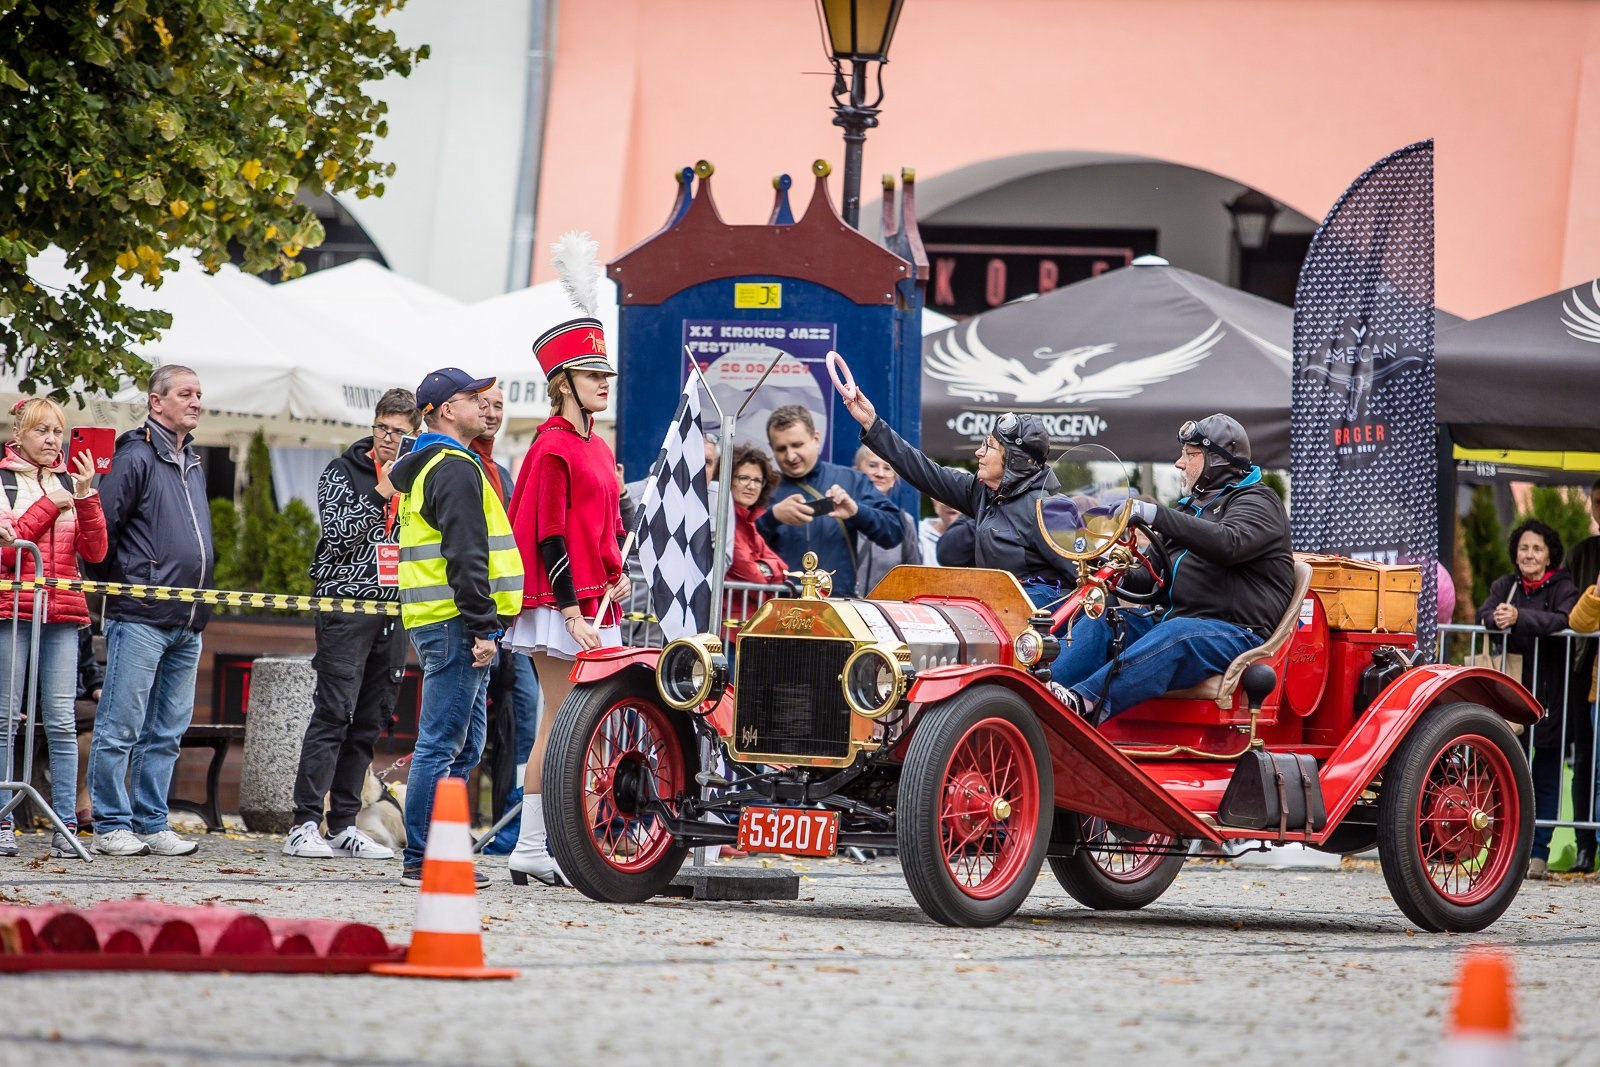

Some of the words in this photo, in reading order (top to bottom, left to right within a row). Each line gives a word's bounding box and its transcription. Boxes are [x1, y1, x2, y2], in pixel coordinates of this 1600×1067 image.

[935, 258, 1109, 306] KOR
[689, 325, 713, 337] XX
[720, 326, 786, 339] KROKUS
[789, 328, 831, 340] JAZZ
[955, 411, 1100, 437] GRIRGEN
[780, 607, 816, 630] Ford
[1291, 642, 1324, 663] Ford
[742, 724, 758, 749] 1914
[740, 812, 749, 846] CAL
[749, 812, 828, 851] 53207
[827, 819, 835, 851] 1914
